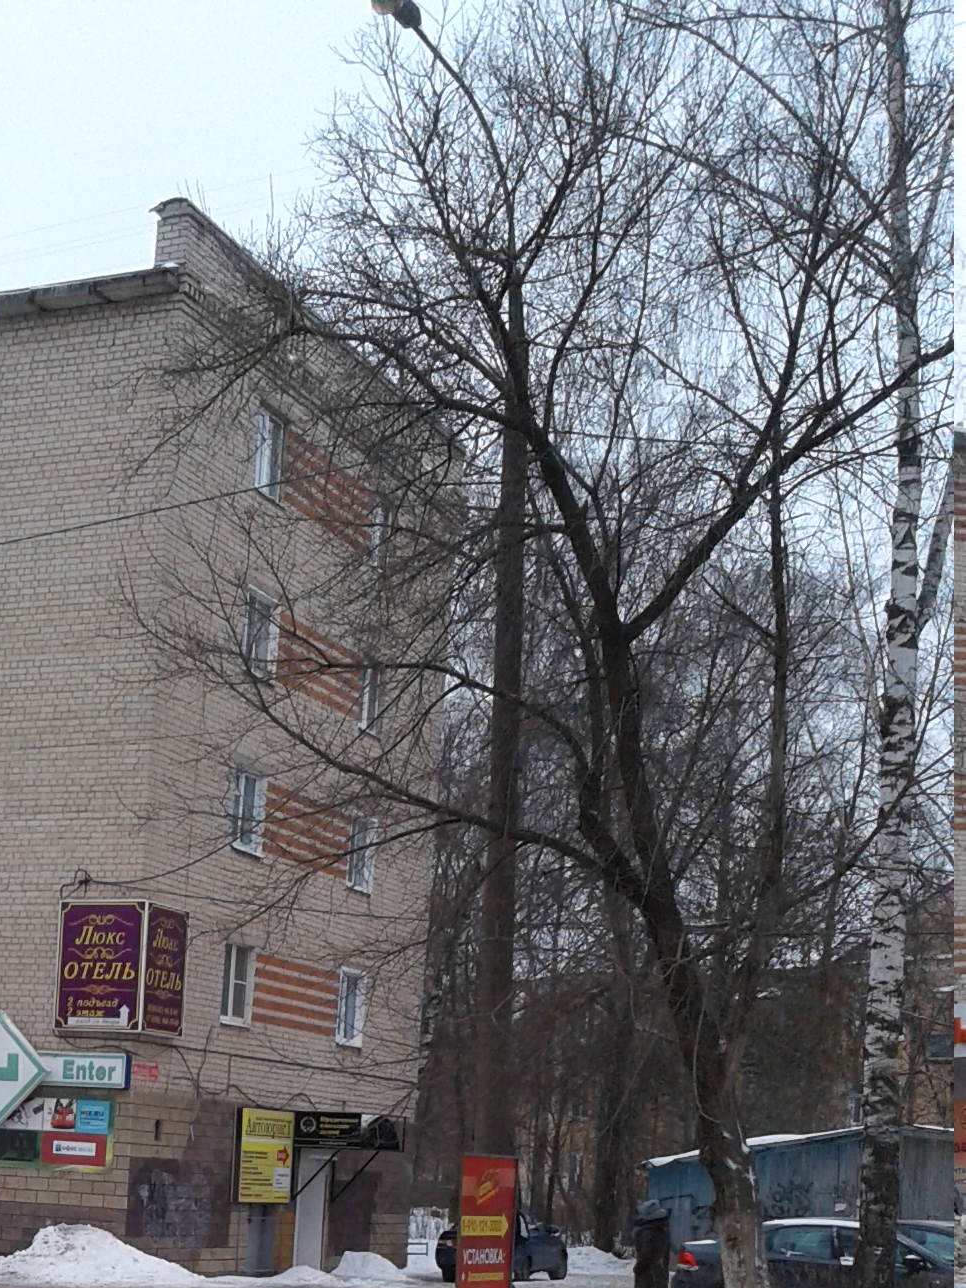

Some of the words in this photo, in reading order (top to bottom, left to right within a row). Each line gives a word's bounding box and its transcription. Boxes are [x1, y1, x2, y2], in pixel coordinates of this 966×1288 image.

[75, 926, 126, 945] Люкс
[63, 963, 136, 980] ОТЕЛЬ
[146, 968, 182, 991] ОТЕЛЬ
[76, 997, 119, 1008] подъезд
[66, 1007, 73, 1016] 2
[62, 1060, 116, 1082] Enter
[462, 1248, 506, 1265] УСТАНОВКА:
